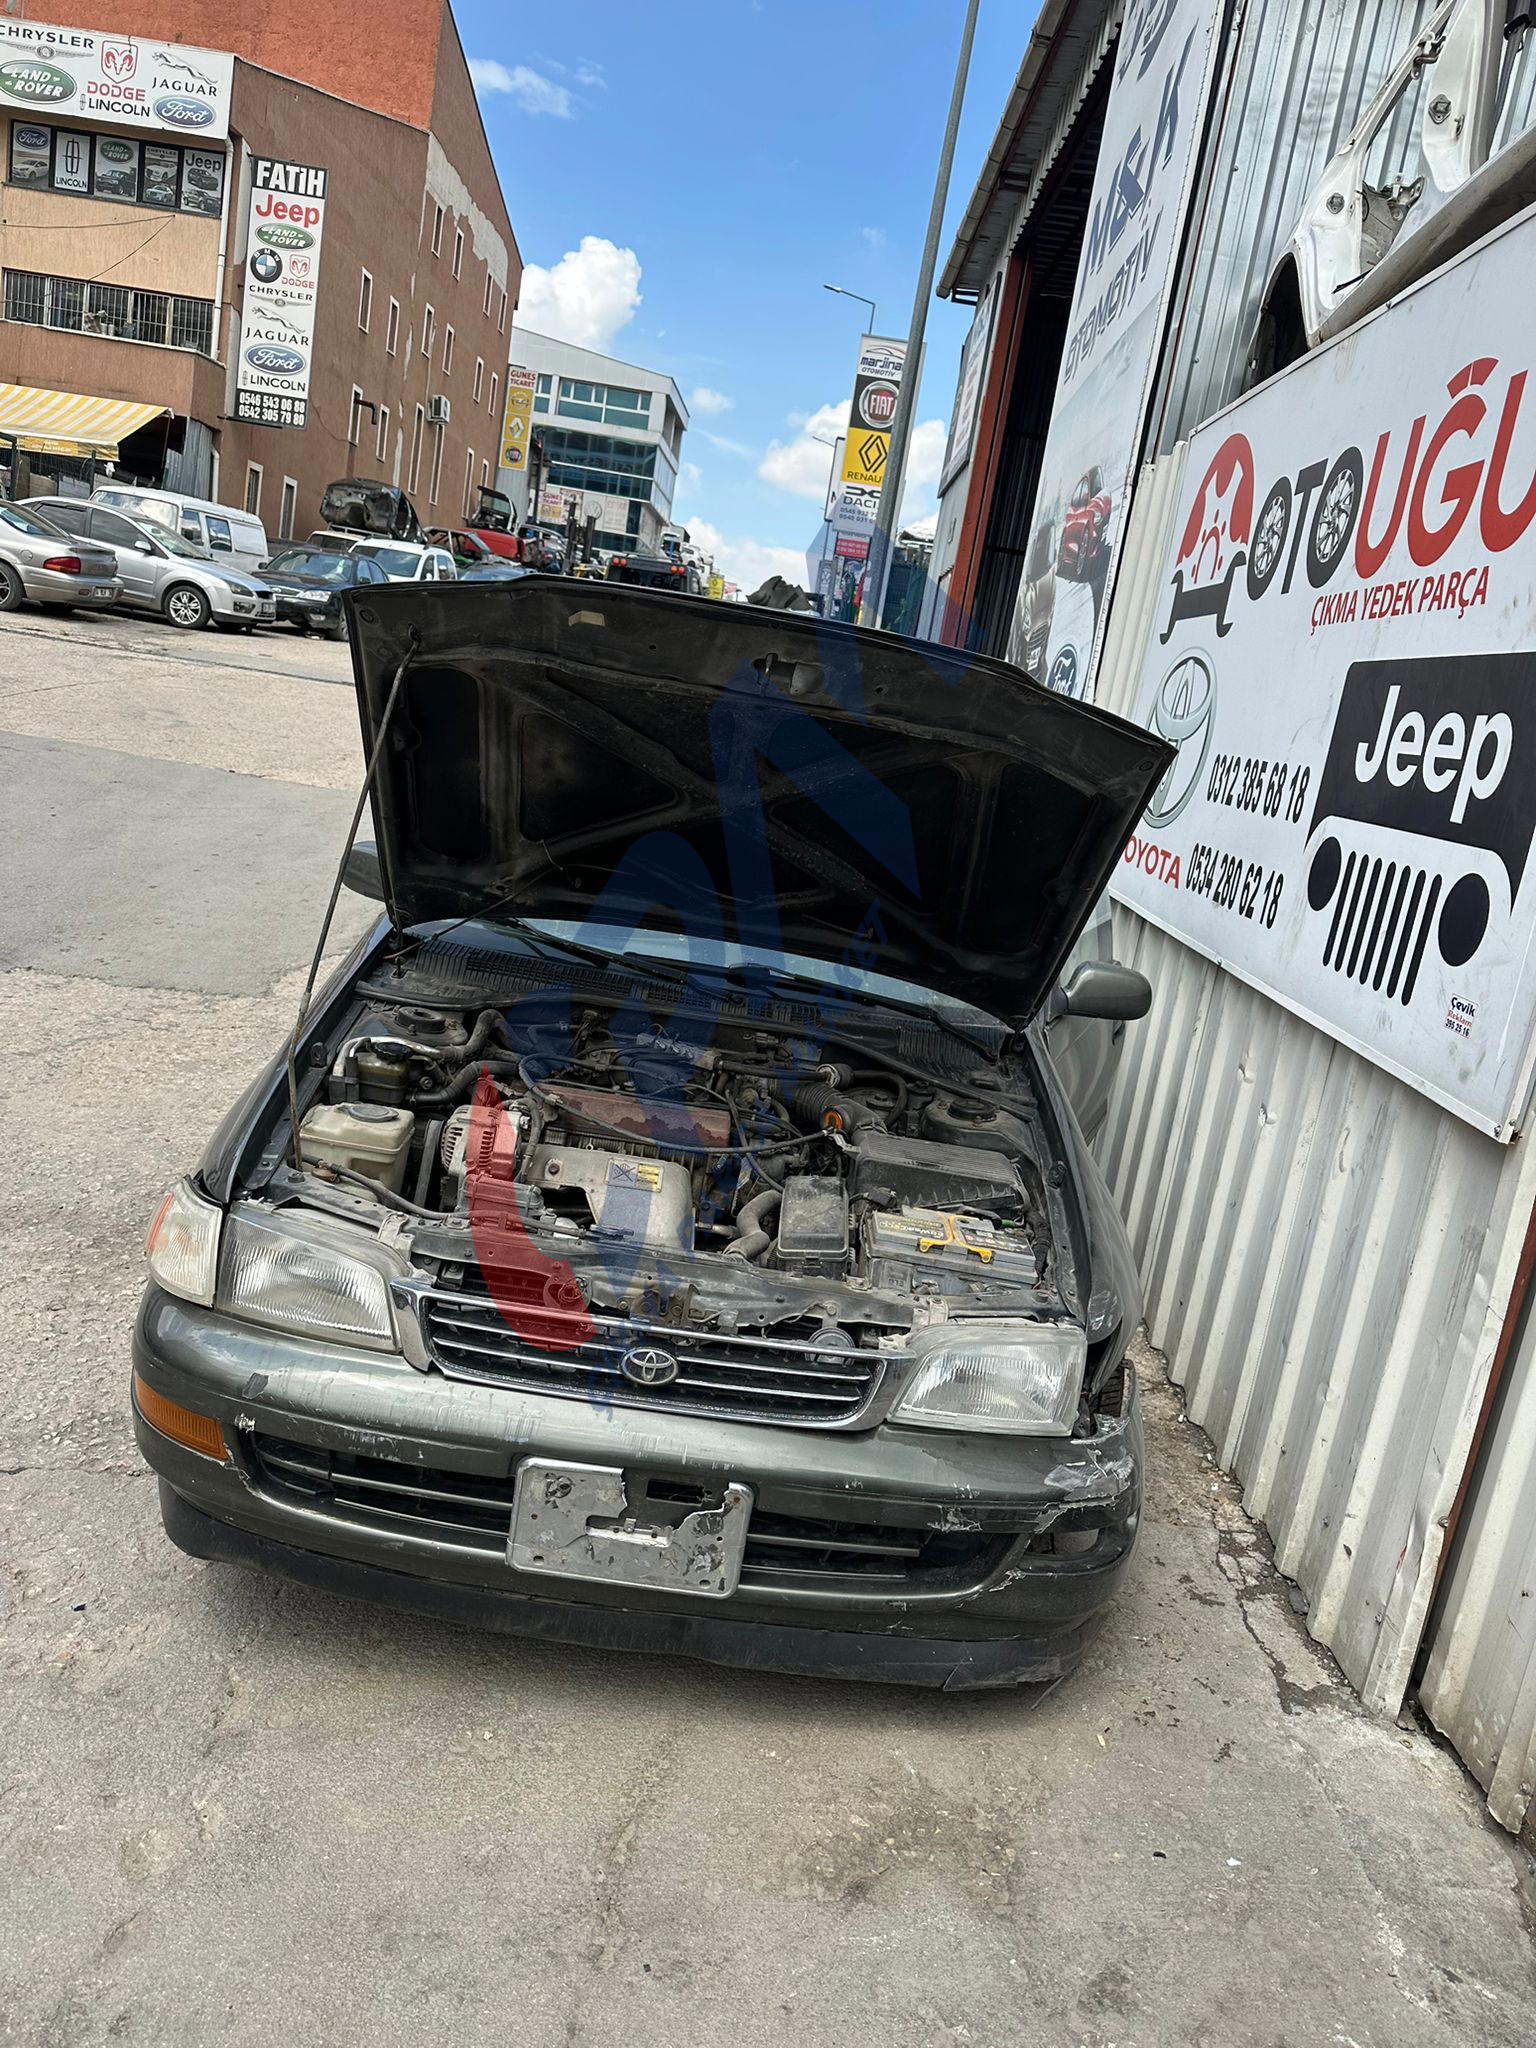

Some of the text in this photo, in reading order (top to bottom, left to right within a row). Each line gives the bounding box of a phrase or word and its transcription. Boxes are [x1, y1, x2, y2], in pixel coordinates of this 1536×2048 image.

[11, 67, 51, 82] LAND
[14, 80, 64, 98] ROVER
[87, 81, 146, 102] DODGE
[152, 77, 218, 97] JAGUAR
[88, 98, 151, 118] LINCOLN
[161, 101, 208, 123] Ford
[18, 129, 46, 146] Ford
[185, 153, 222, 172] Jeep
[55, 176, 87, 189] LINCOLN
[255, 194, 320, 228] Jeep
[268, 227, 297, 238] LAND
[270, 233, 305, 248] ROVER
[254, 248, 281, 262] BMW
[281, 277, 315, 289] DODGE
[249, 285, 313, 301] CHRYSLER
[245, 327, 309, 346] JAGUAR
[253, 348, 299, 370] Ford
[250, 374, 306, 392] LINCOLN
[239, 392, 261, 406] 0546
[262, 396, 280, 409] 543
[294, 400, 306, 413] 88
[869, 394, 894, 416] FIAT
[239, 404, 260, 418] 0542
[262, 408, 278, 422] 305
[280, 411, 292, 424] 79
[847, 471, 882, 483] RENAU
[843, 496, 877, 509] DACI
[1311, 565, 1490, 636] ÇIKMA YEDEK PARÇA
[1354, 684, 1513, 825] Jeep
[1207, 753, 1311, 824] 0312 385 68 18
[1124, 835, 1181, 889] OYOTA
[1185, 842, 1284, 930] 0534 280 62 18
[1451, 997, 1476, 1017] Çevik
[1448, 1010, 1472, 1027] Reklam
